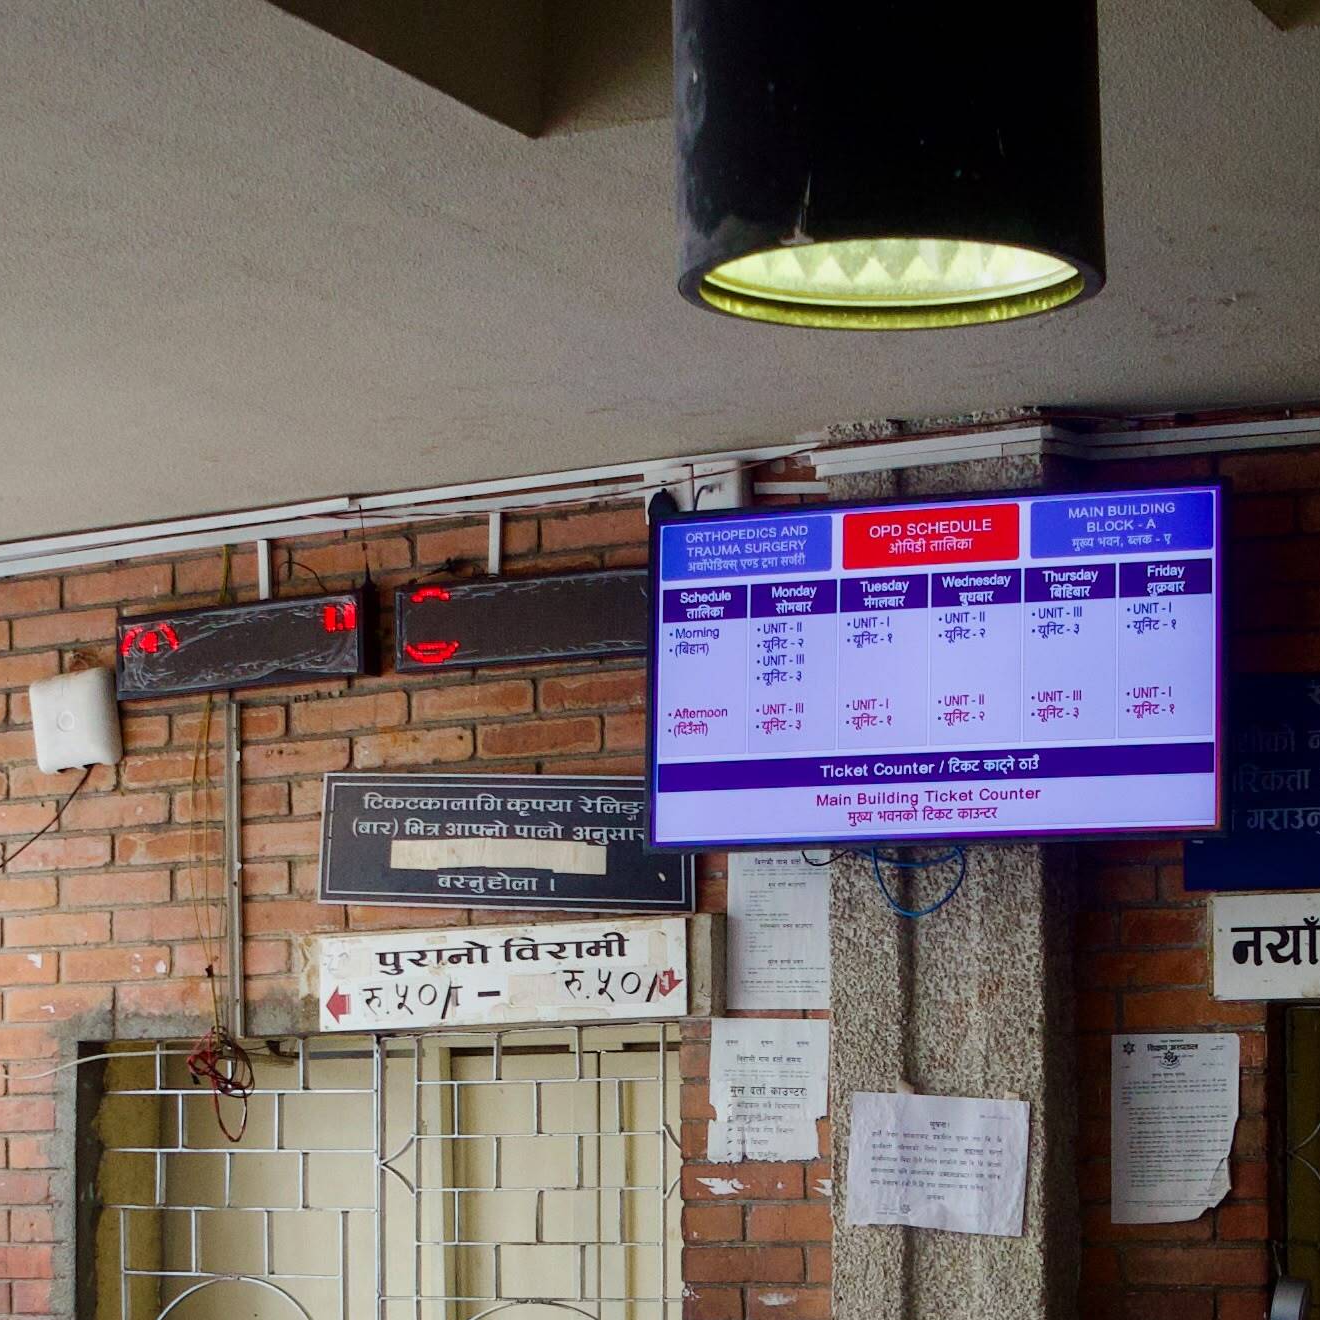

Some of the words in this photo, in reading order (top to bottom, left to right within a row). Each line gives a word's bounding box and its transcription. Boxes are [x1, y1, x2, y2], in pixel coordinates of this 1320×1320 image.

[1068, 507, 1104, 519] MAIN
[1107, 502, 1176, 516] BUILDING
[870, 524, 901, 538] OPD
[906, 518, 992, 536] SCHEDULE
[1086, 520, 1133, 533] BLOCK
[1146, 519, 1157, 530] A
[686, 527, 777, 543] ORTHOPEDICS
[781, 525, 808, 537] AND
[686, 545, 741, 557] TRAUMA
[744, 540, 807, 554] SURGERY
[929, 537, 973, 552] तालिका
[1042, 569, 1098, 583] Thursday
[1147, 565, 1185, 579] Friday
[860, 580, 910, 594] Tuesday
[942, 574, 1011, 588] Wednesday
[680, 590, 731, 604] Schedule
[771, 585, 817, 600] Monday
[686, 604, 724, 619] तालिका
[1038, 607, 1063, 619] UNIT
[1133, 603, 1158, 615] UNIT
[853, 617, 877, 629] UNIT
[945, 612, 969, 624] UNIT
[763, 623, 786, 634] UNIT
[1074, 623, 1080, 634] ३
[1171, 619, 1177, 630] १
[675, 626, 720, 641] Morning
[887, 633, 893, 644] १
[979, 628, 986, 639] २
[798, 638, 804, 649] २
[763, 654, 786, 666] UNIT
[796, 671, 802, 682] ३
[1037, 691, 1063, 702] UNIT
[1133, 687, 1159, 699] UNIT
[852, 699, 877, 711] UNIT
[944, 695, 969, 707] UNIT
[673, 708, 728, 719] Afternoon
[762, 703, 786, 715] UNIT
[1073, 707, 1080, 718] ३
[1170, 703, 1175, 714] १
[886, 715, 892, 726] १
[979, 711, 985, 721] २
[796, 720, 802, 731] ३
[820, 763, 868, 778] Ticket
[873, 760, 935, 777] Counter
[948, 756, 980, 774] टिकट
[816, 793, 851, 807] Main
[857, 790, 918, 807] Building
[924, 788, 973, 803] Ticket
[979, 787, 1041, 801] Counter
[847, 810, 872, 827] मुख्य
[877, 806, 918, 823] भवनको
[922, 806, 953, 821] टिकट
[957, 806, 998, 820] काउन्टर
[352, 817, 399, 837] (बार)
[403, 816, 441, 836] भित्र
[445, 820, 510, 838] आफ्नो
[514, 821, 565, 839] पालो
[375, 939, 490, 976] पुरानो
[499, 931, 630, 963] विरामी
